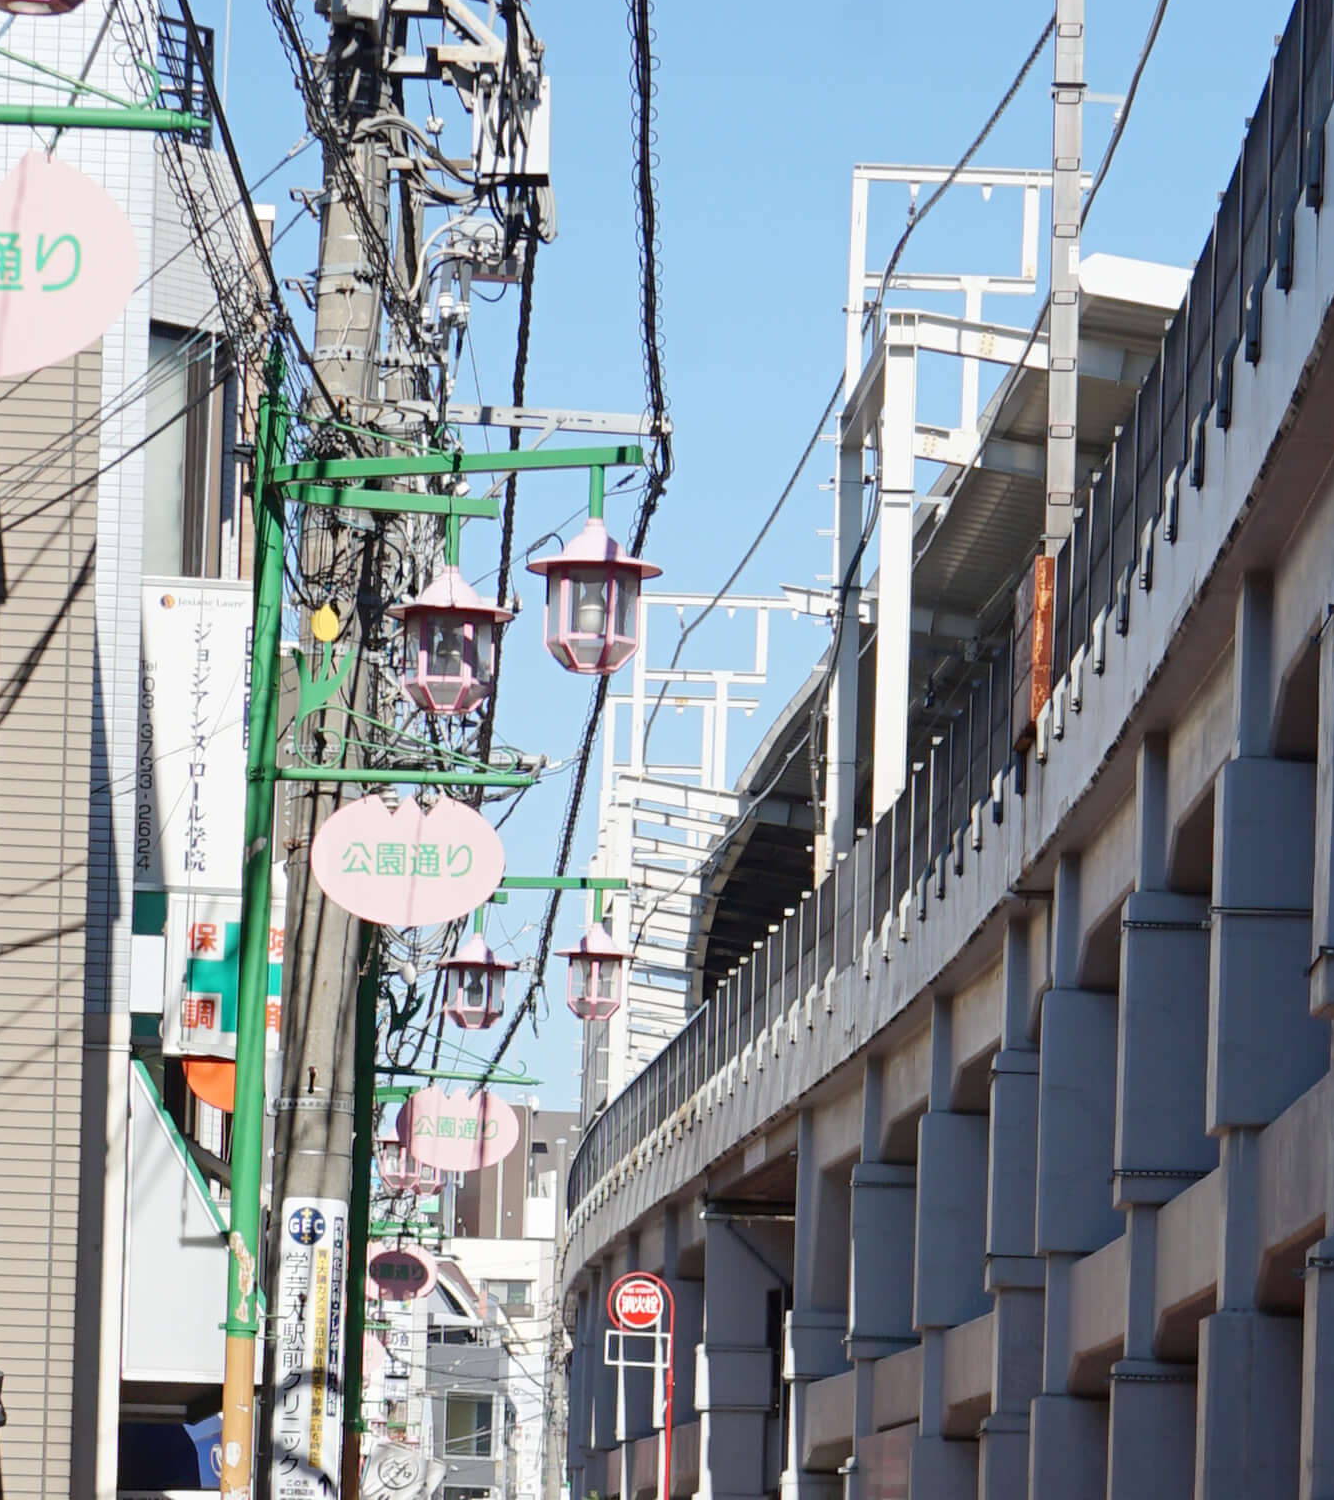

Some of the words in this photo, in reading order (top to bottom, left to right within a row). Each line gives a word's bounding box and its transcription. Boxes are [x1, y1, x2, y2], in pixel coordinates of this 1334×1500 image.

[340, 841, 475, 880] 公園通り
[414, 1115, 499, 1141] 公園通り
[289, 1217, 325, 1235] GEC
[279, 1251, 309, 1476] 学芸大駅前クリニック
